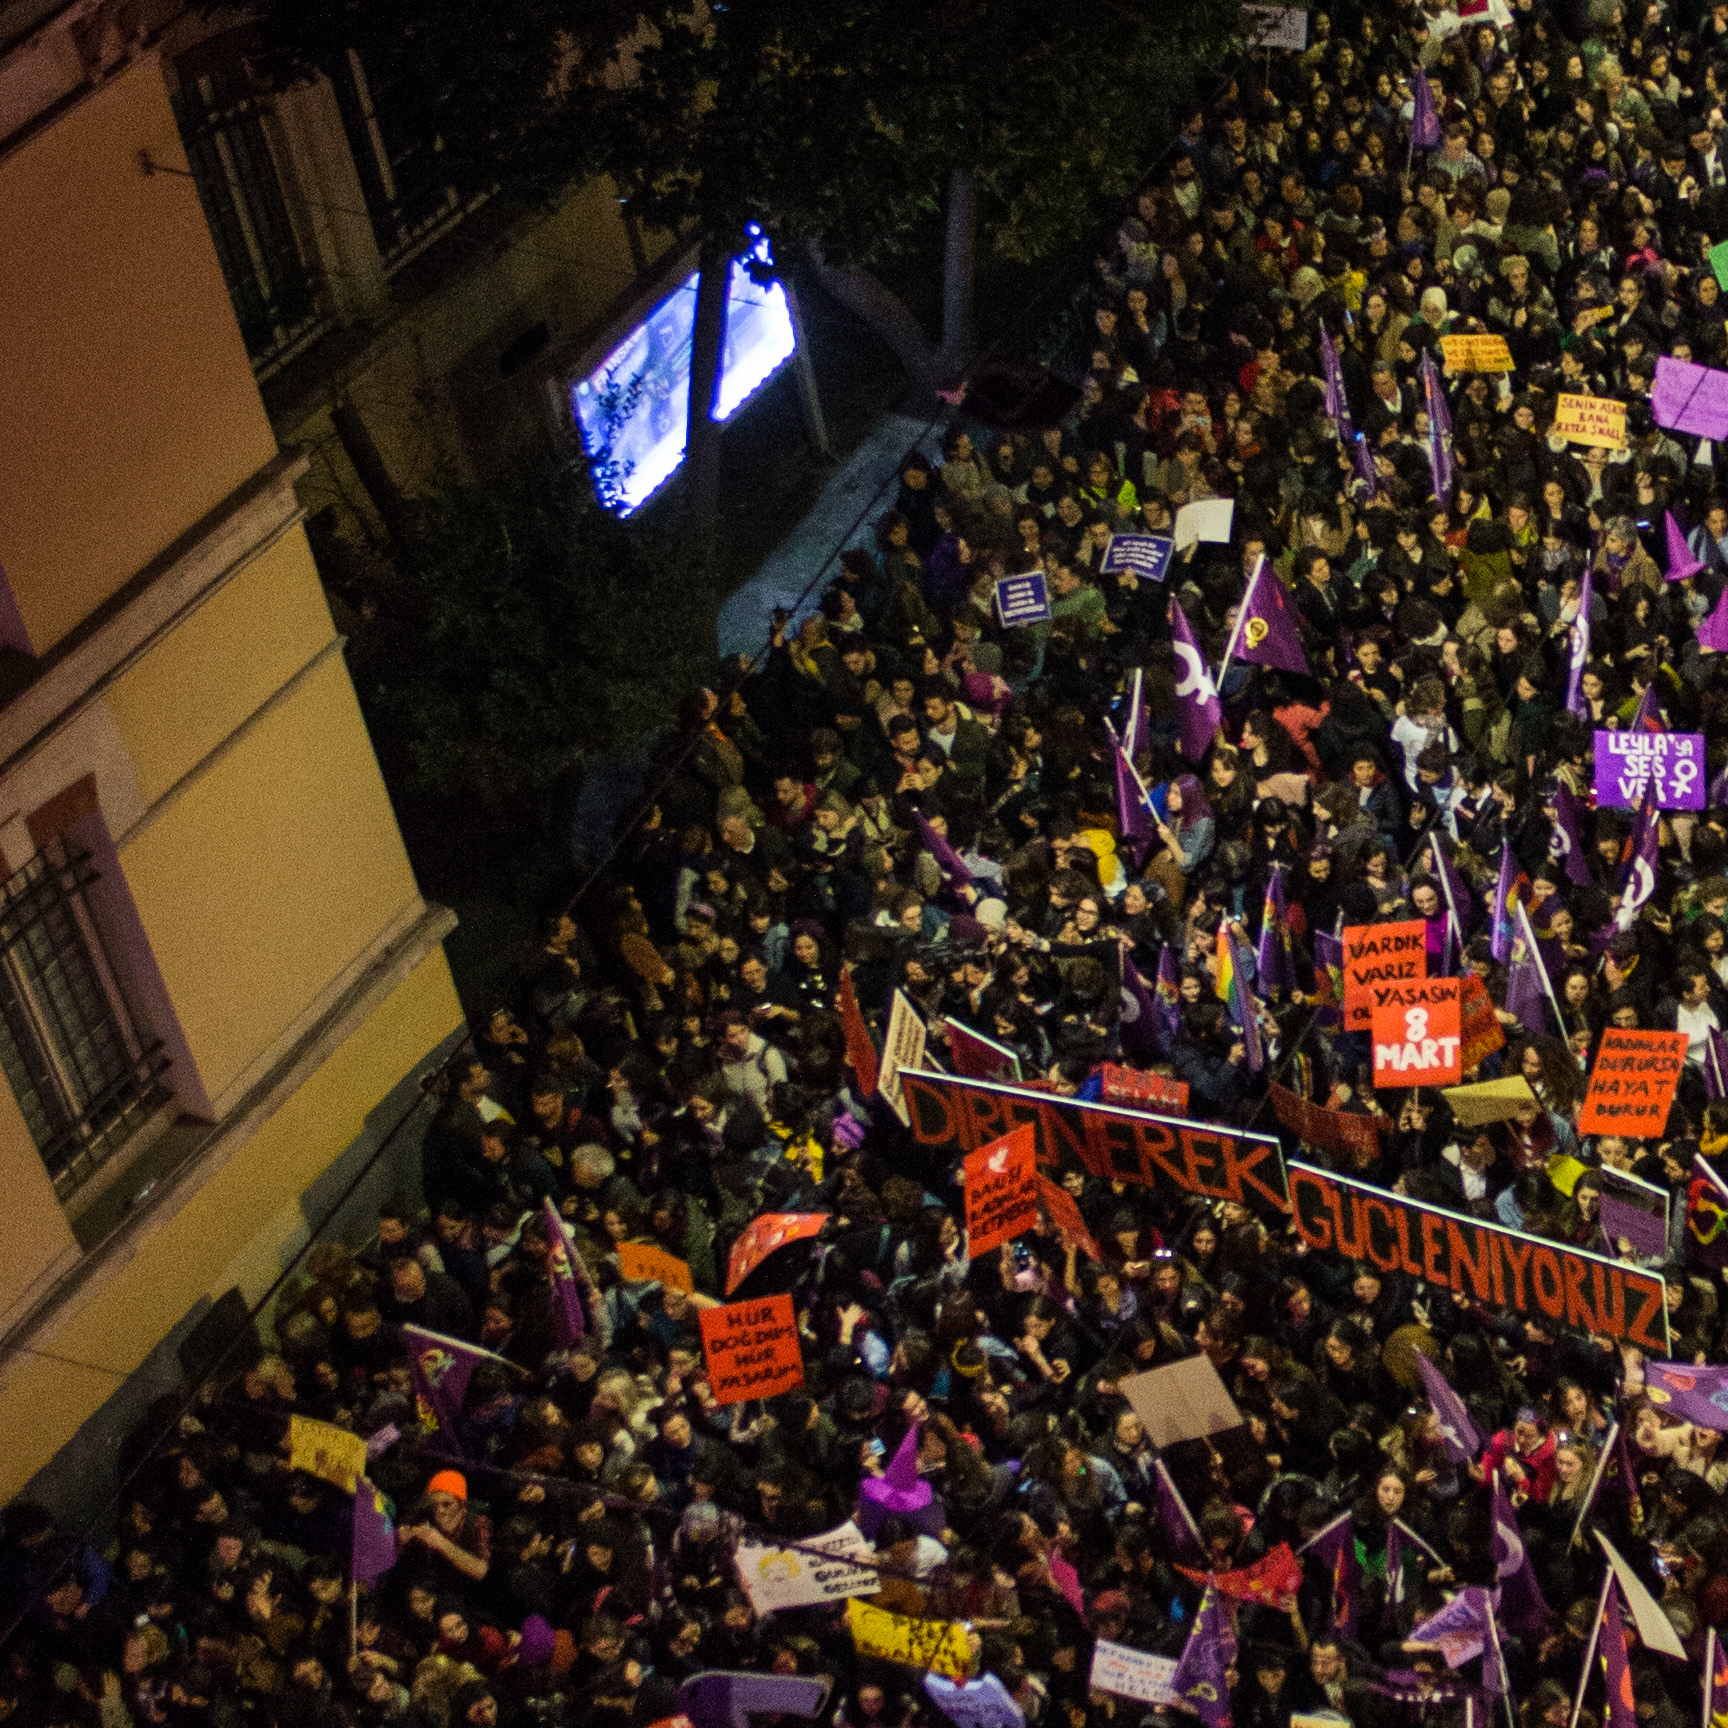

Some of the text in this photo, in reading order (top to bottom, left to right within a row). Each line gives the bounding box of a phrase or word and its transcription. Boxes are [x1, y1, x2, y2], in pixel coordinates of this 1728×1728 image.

[1623, 754, 1667, 778] SES
[1350, 933, 1425, 960] VARDIK
[1405, 1007, 1429, 1043] 8
[1374, 1036, 1461, 1072] MART
[1592, 1078, 1671, 1097] HAYAT
[1596, 1102, 1661, 1119] DURUR
